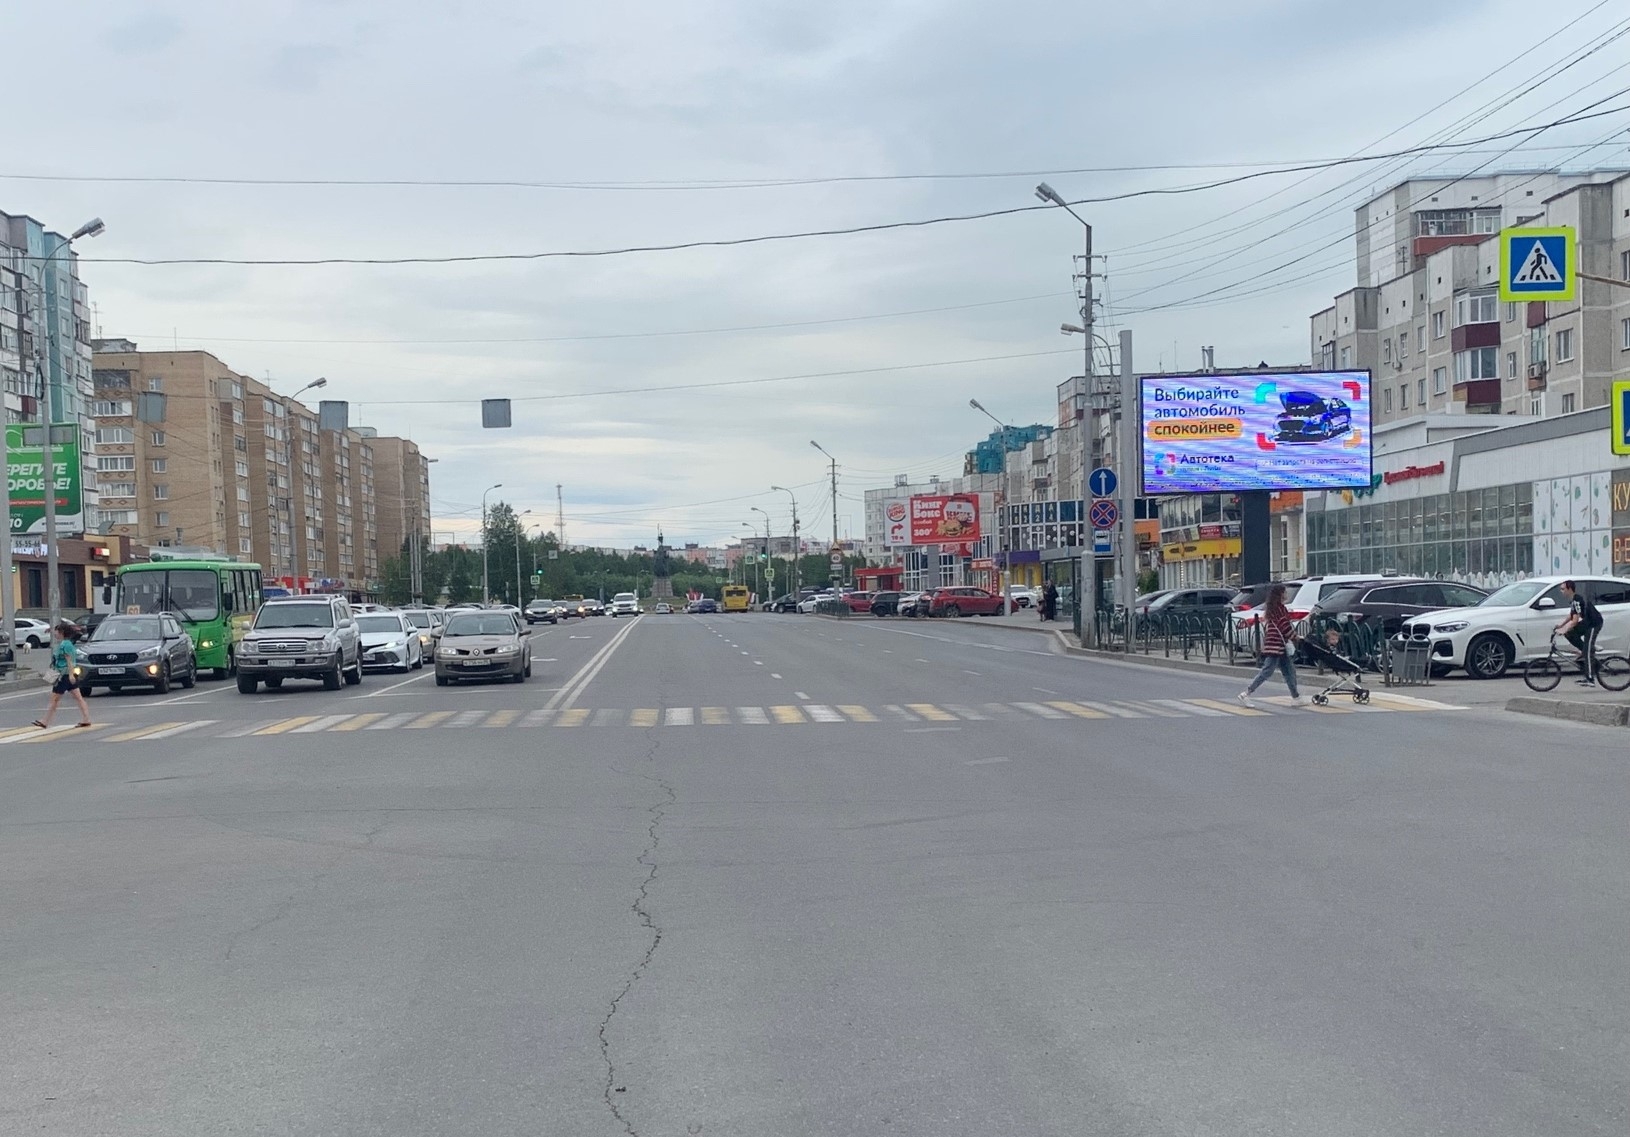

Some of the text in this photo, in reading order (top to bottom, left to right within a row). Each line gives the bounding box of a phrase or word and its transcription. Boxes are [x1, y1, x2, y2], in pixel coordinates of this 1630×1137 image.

[1155, 386, 1239, 402] Выбирайте
[1154, 403, 1246, 418] автомобиль
[1154, 421, 1235, 436] спокойнее
[1180, 454, 1235, 464] Автотека
